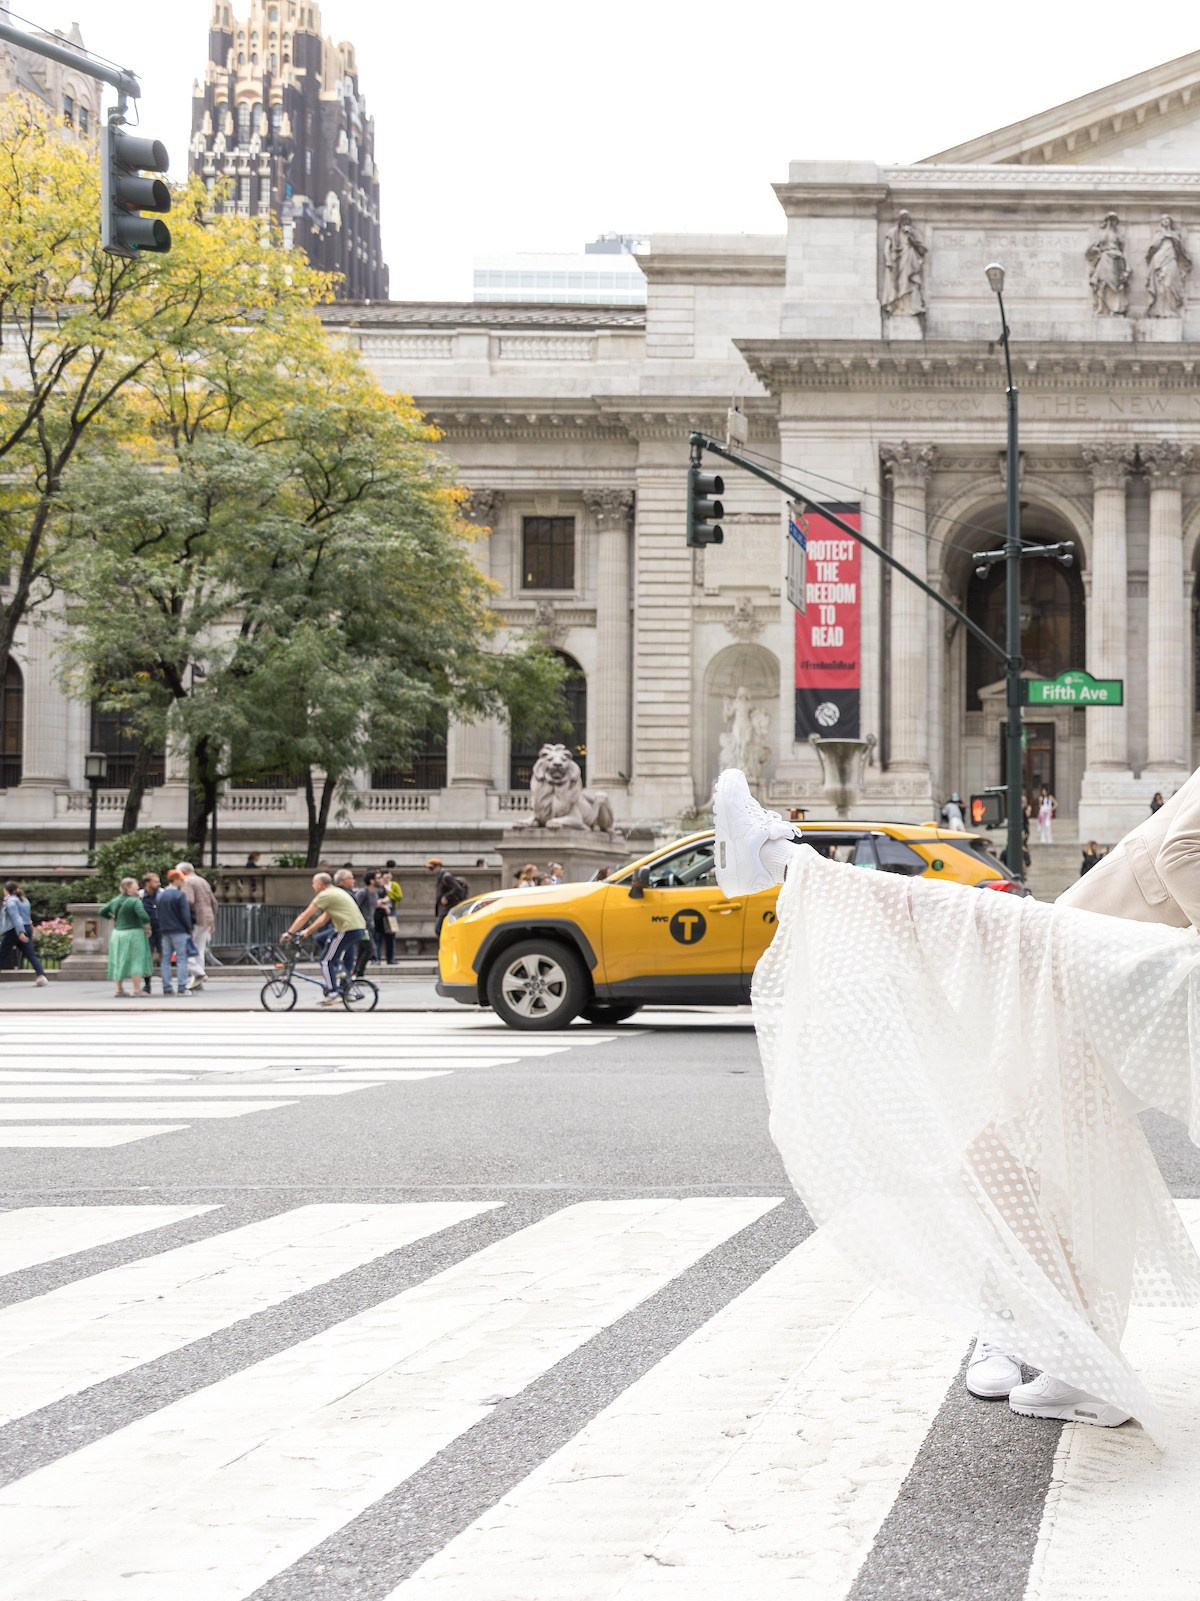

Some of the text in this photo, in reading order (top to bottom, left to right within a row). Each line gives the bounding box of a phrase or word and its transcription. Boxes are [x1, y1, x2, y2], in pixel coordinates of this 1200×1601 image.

[940, 235, 1080, 249] THE ASTOR LIBRARY
[888, 398, 982, 412] MDCCCXCV
[1036, 396, 1089, 415] THE
[1107, 397, 1171, 415] NEW
[806, 540, 855, 560] ROTECT
[815, 561, 839, 582] THE
[806, 583, 856, 604] REEDOM
[818, 605, 836, 625] TO
[811, 626, 844, 647] READ
[1042, 685, 1108, 700] Fifth Ave
